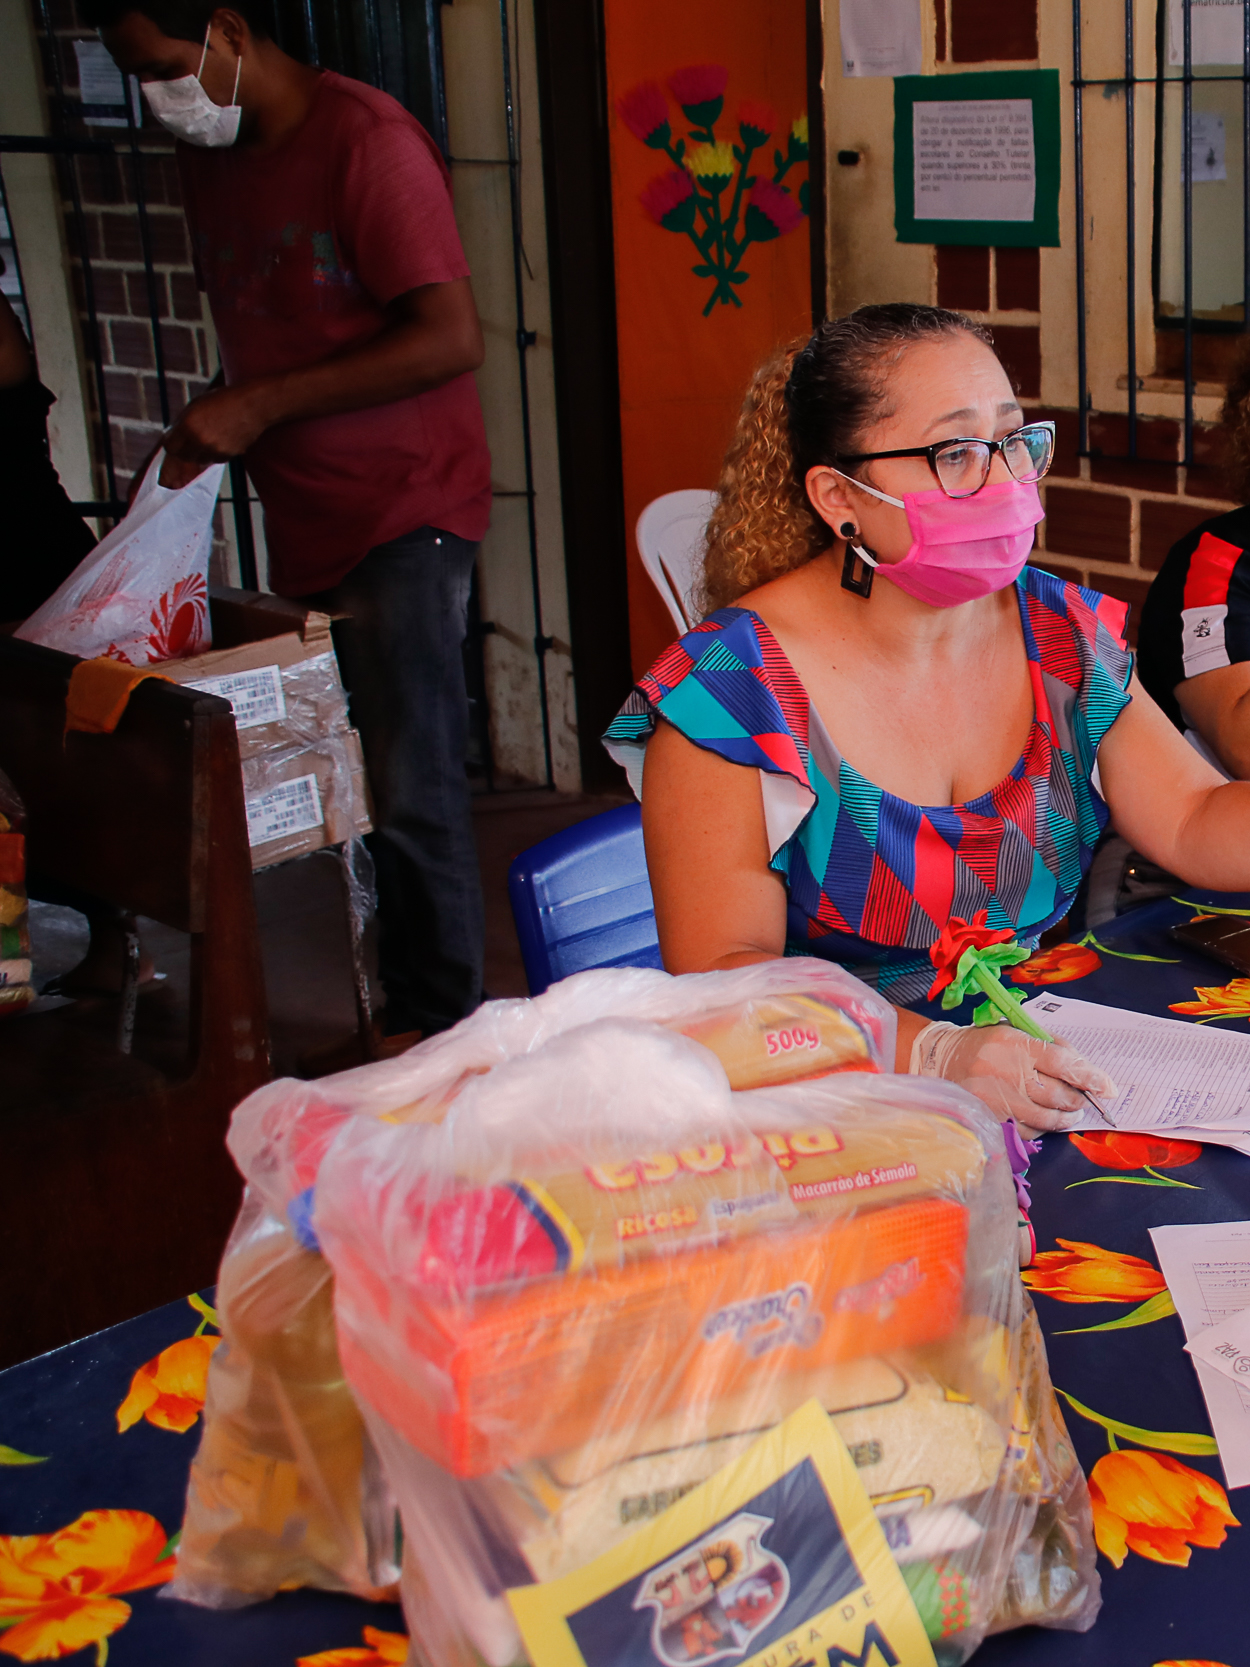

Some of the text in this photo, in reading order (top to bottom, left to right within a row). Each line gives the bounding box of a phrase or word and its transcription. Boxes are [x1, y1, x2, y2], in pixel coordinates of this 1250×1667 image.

[766, 1026, 821, 1057] 500g
[792, 1161, 917, 1201] Macarrão de Sêmola
[1214, 1339, 1241, 1360] PAZ
[841, 1591, 876, 1623] DE
